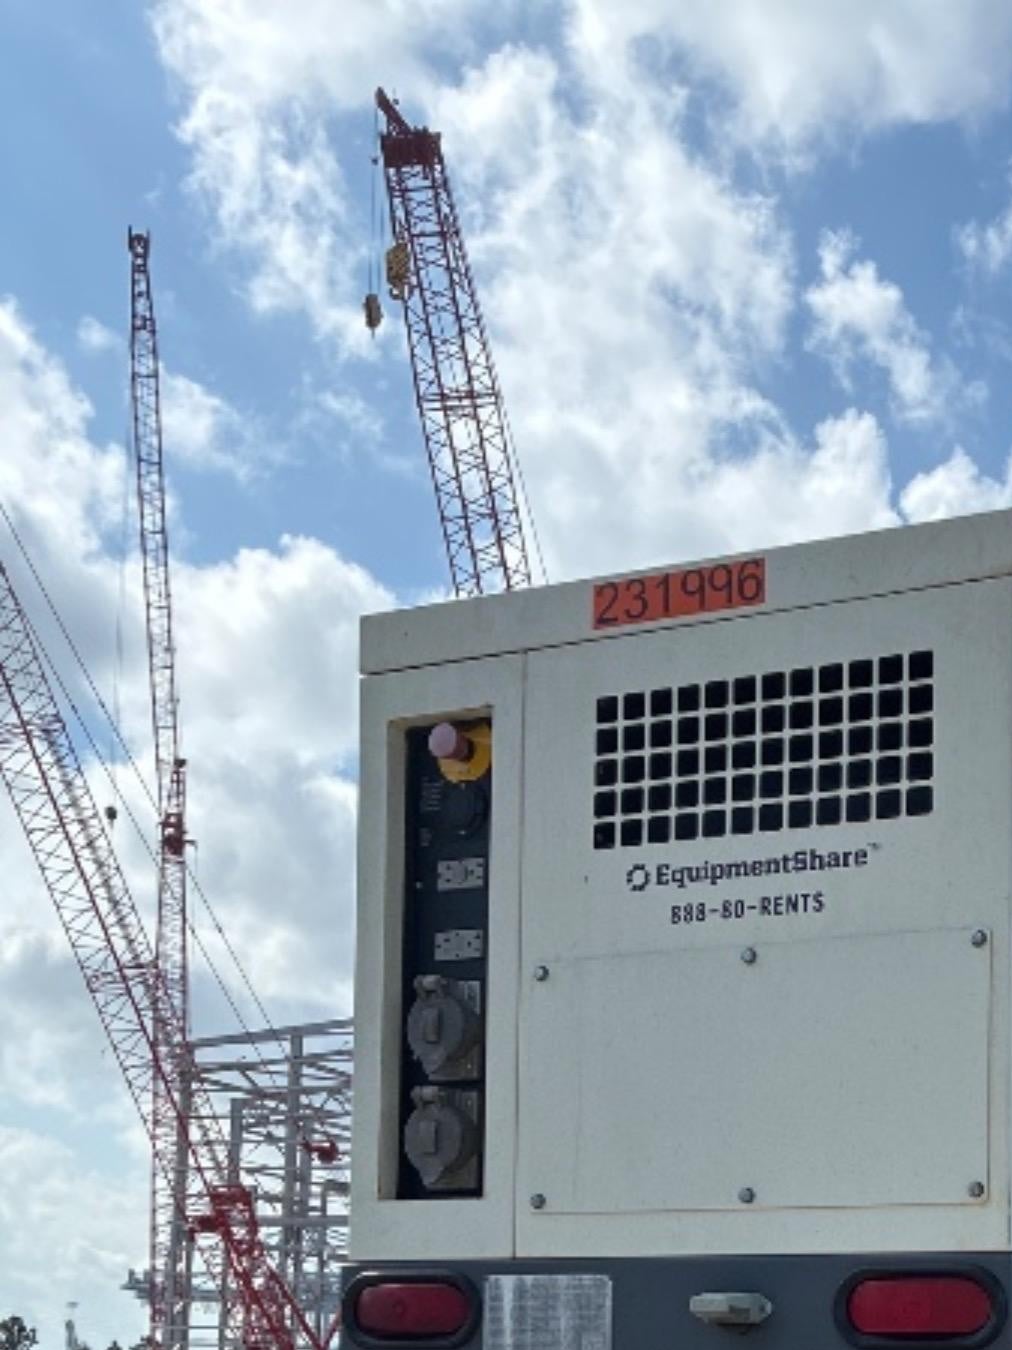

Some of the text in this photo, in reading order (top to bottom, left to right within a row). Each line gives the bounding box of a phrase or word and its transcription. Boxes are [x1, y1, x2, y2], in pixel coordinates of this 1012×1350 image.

[595, 560, 765, 625] 231996
[655, 848, 869, 888] EquipmentShare
[671, 891, 825, 924] 888-80-RENTS
